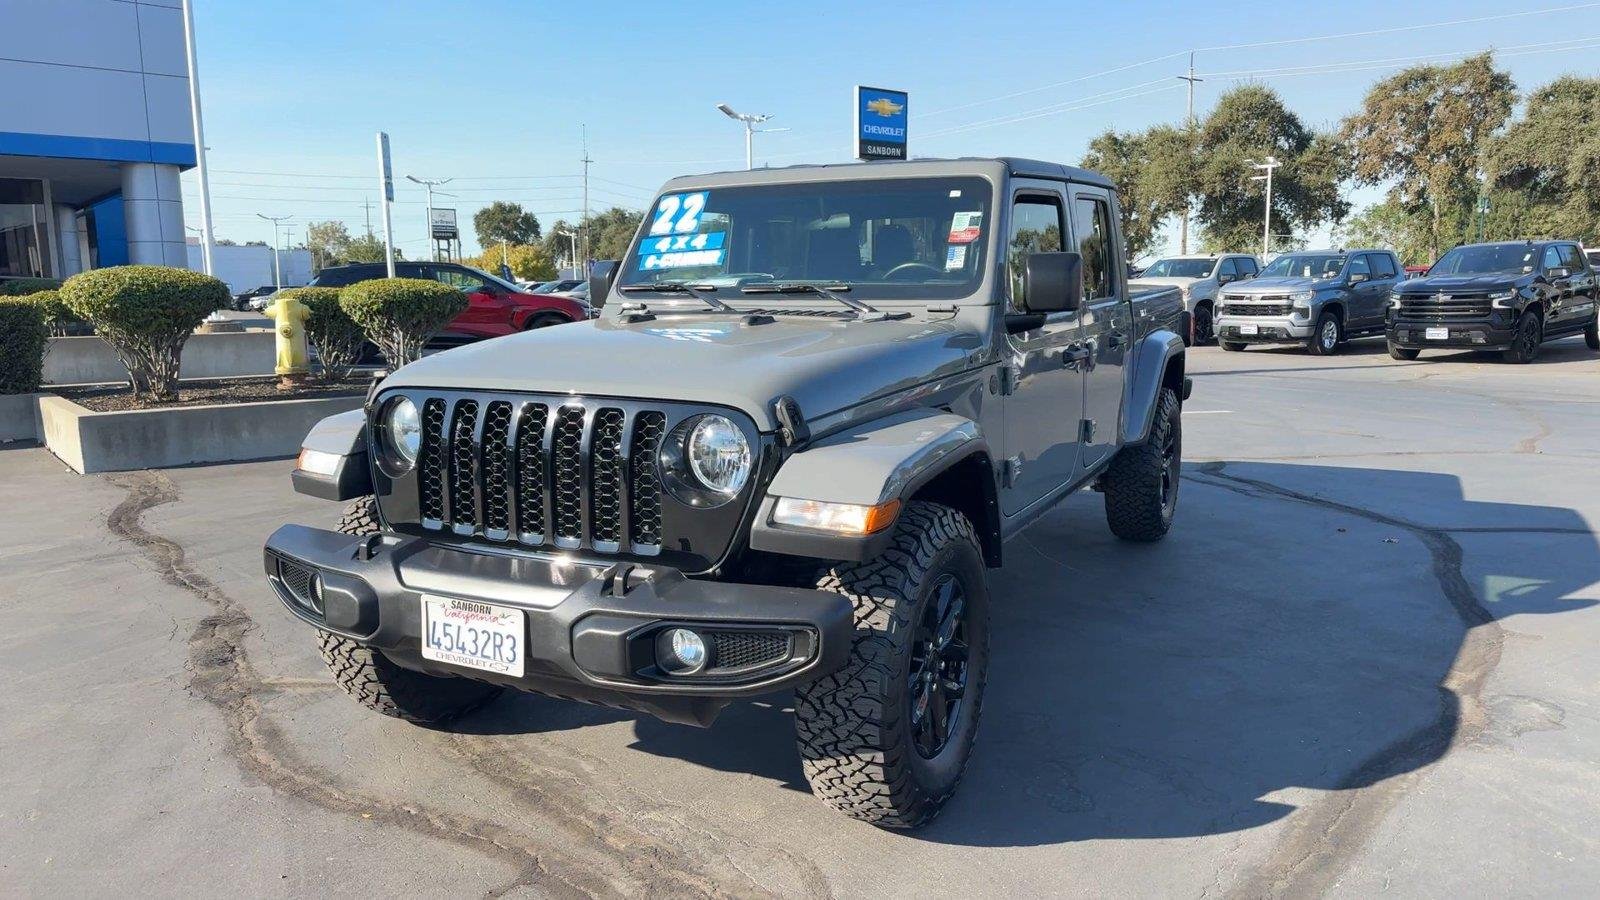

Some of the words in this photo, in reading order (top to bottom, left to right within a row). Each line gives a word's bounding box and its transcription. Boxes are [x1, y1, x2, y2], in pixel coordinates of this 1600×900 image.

[864, 125, 905, 137] CHEVROLET
[867, 145, 901, 157] SANBORN
[650, 193, 705, 235] 22
[451, 600, 492, 615] SANBORN
[431, 621, 517, 663] 45432R3
[436, 651, 487, 668] CHEVROLET
